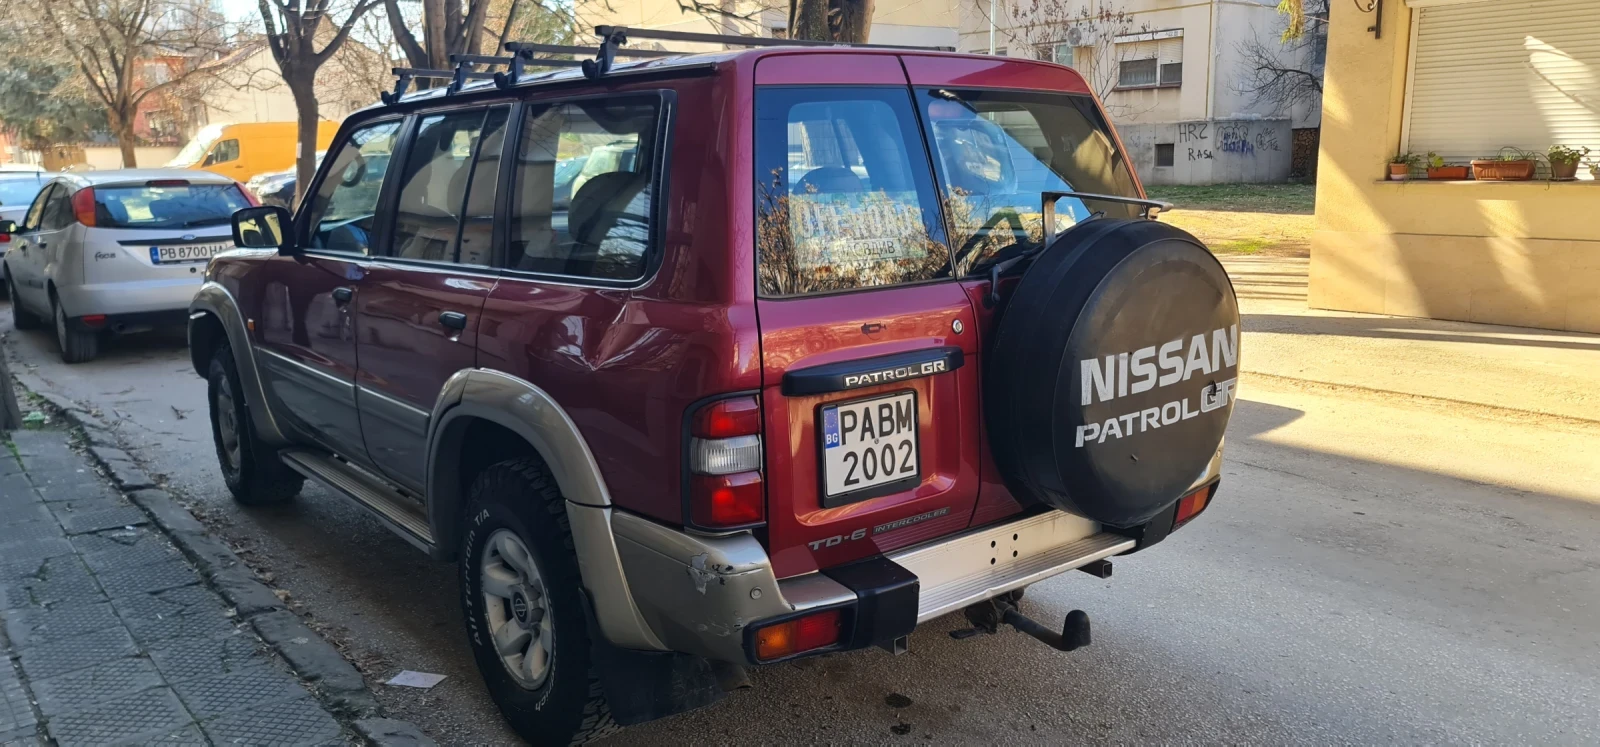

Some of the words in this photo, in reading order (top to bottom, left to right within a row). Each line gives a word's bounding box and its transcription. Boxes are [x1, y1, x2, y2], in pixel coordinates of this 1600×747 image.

[159, 248, 177, 259] PB
[179, 247, 208, 258] 8700
[845, 367, 918, 387] PATROL
[921, 360, 945, 375] GR
[1080, 324, 1238, 406] NISSAN
[840, 399, 913, 446] PABM
[1075, 398, 1200, 448] PATROL
[826, 433, 838, 445] BG
[842, 439, 914, 487] 2002
[474, 508, 490, 526] T/A
[874, 508, 948, 533] INTERCOOLER
